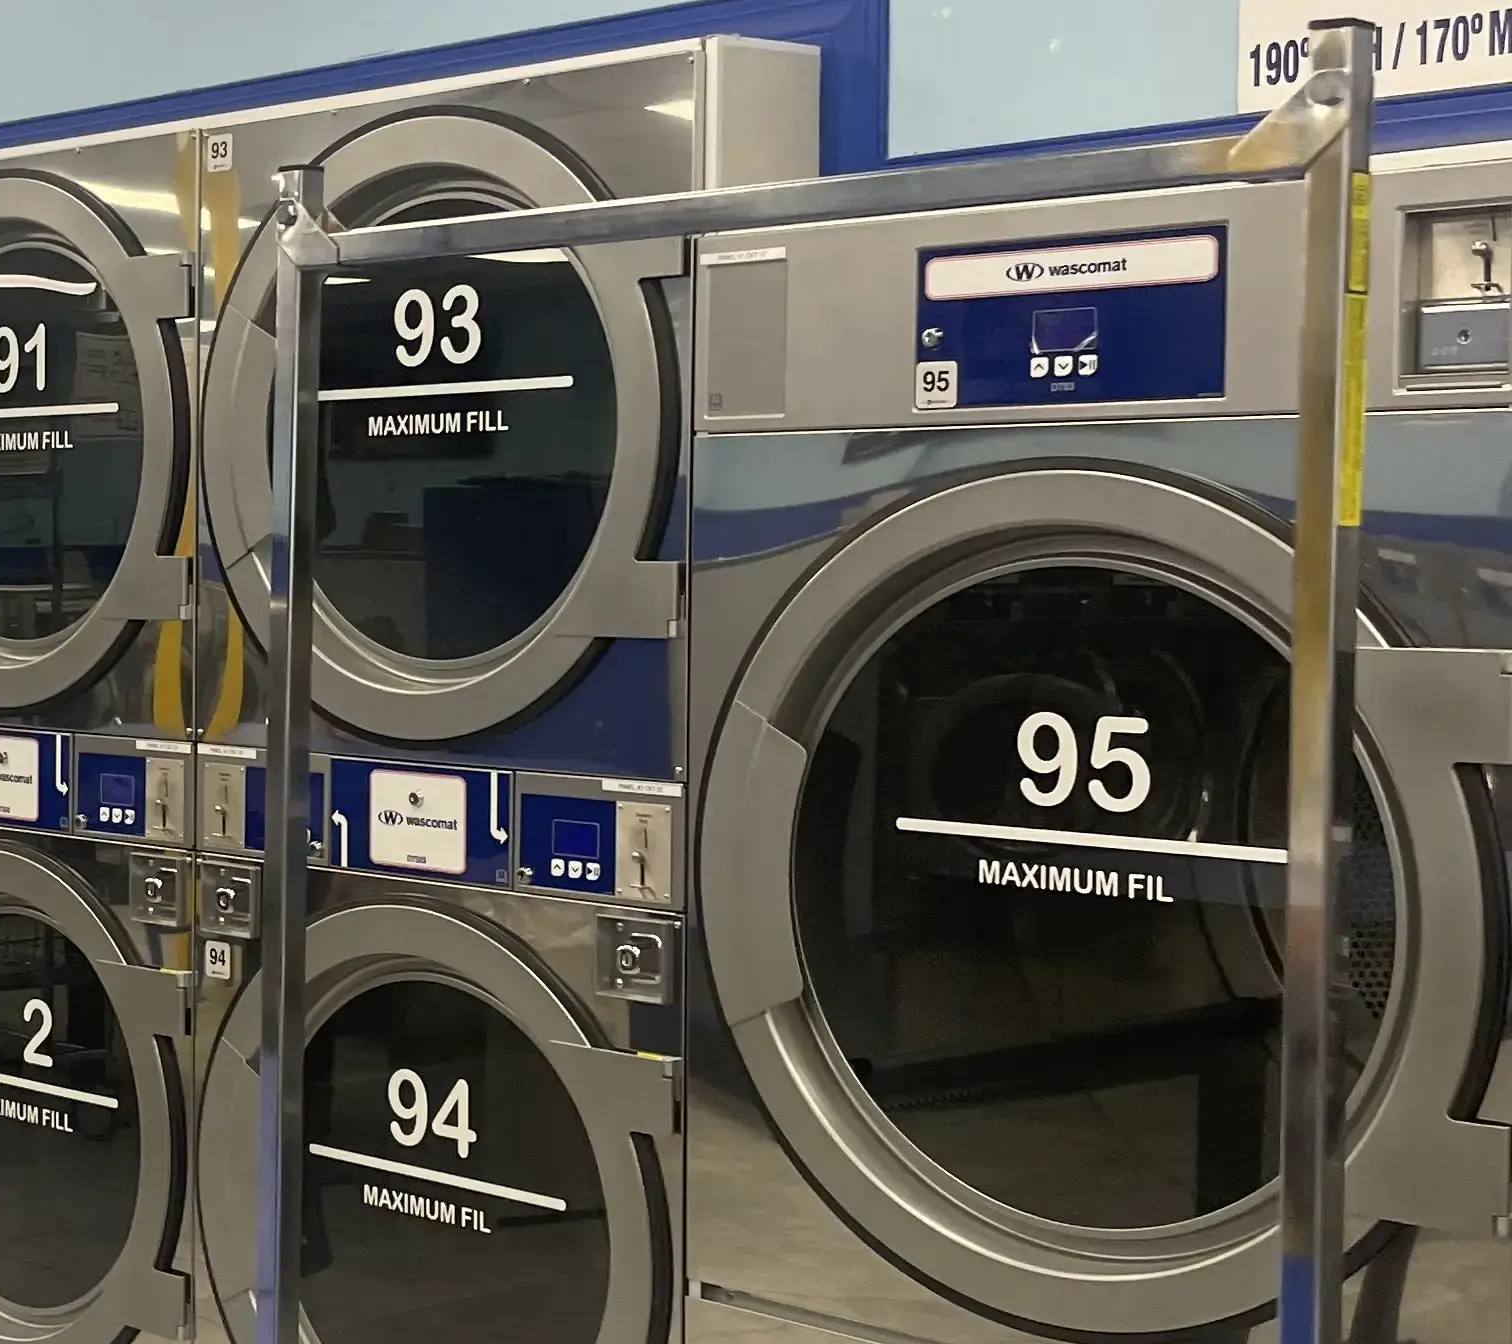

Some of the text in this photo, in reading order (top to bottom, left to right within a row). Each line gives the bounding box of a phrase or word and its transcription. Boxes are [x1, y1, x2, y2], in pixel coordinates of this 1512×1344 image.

[211, 141, 228, 159] 93
[1049, 258, 1128, 277] wascomat
[393, 284, 482, 367] 93
[922, 370, 950, 393] 95
[368, 410, 509, 436] MAXIMUM FILL
[42, 430, 74, 450] FILL
[1017, 711, 1151, 812] 95
[406, 816, 458, 831] wascomat
[978, 859, 1174, 903] MAXIMUM FIL
[209, 948, 226, 966] 94
[23, 998, 54, 1068] 2
[42, 1108, 74, 1133] FILL
[387, 1068, 478, 1159] 94
[363, 1184, 492, 1234] MAXIMUM FIL
